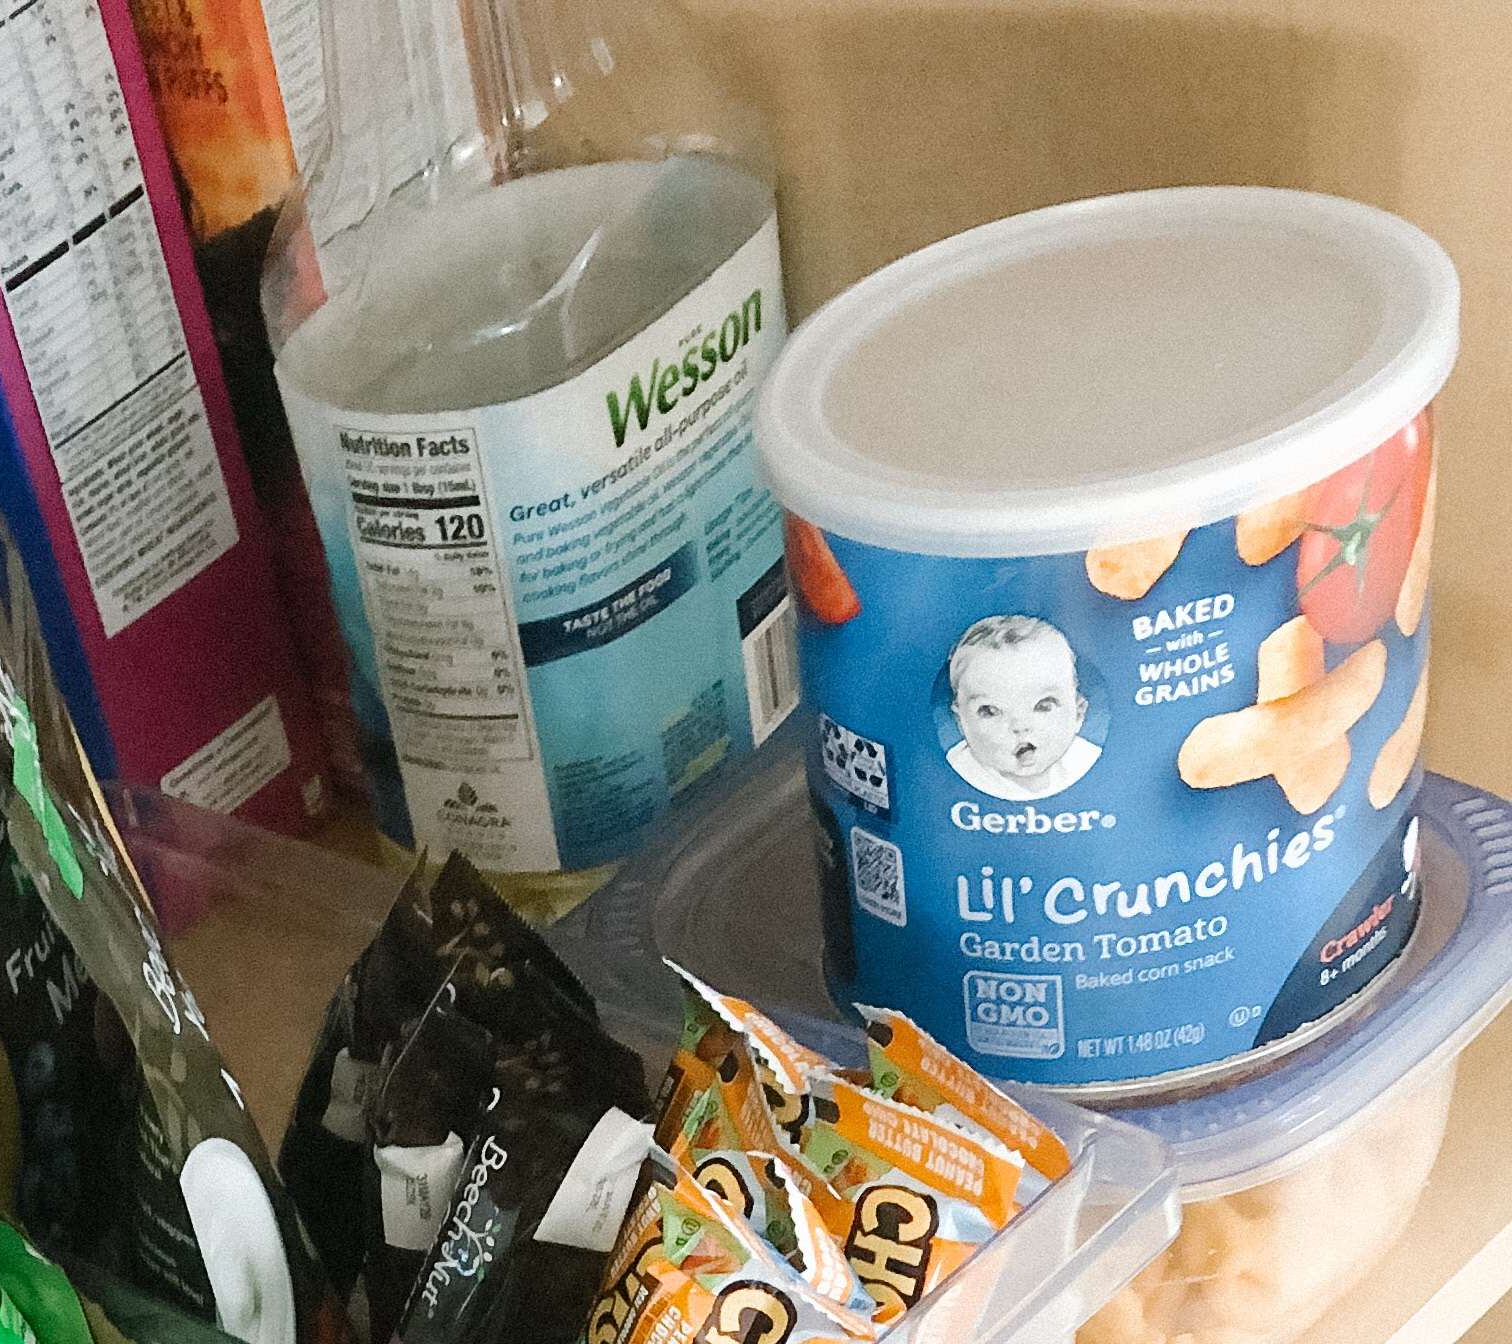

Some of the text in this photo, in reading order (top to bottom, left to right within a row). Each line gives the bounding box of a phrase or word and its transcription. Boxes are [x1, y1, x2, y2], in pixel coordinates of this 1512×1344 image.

[605, 288, 763, 450] Wesson
[340, 432, 470, 458] Nutrition Facts
[509, 493, 578, 524] Great,
[580, 438, 653, 502] versatile
[356, 513, 485, 542] Calories 120
[562, 606, 611, 636] TASTE
[636, 568, 674, 606] FOOD
[1131, 592, 1237, 641] BAKED
[1164, 627, 1206, 652] with
[1133, 662, 1237, 707] GRAINS
[1138, 643, 1231, 684] WHOLE
[950, 801, 1102, 836] Gerber
[1043, 809, 1338, 926] Crunchies
[959, 913, 1230, 964] Garden Tomato
[974, 977, 1050, 1003] NON
[1074, 946, 1237, 991] Baked corn snack
[1319, 965, 1339, 987] 8+
[975, 1002, 1051, 1028] GMO
